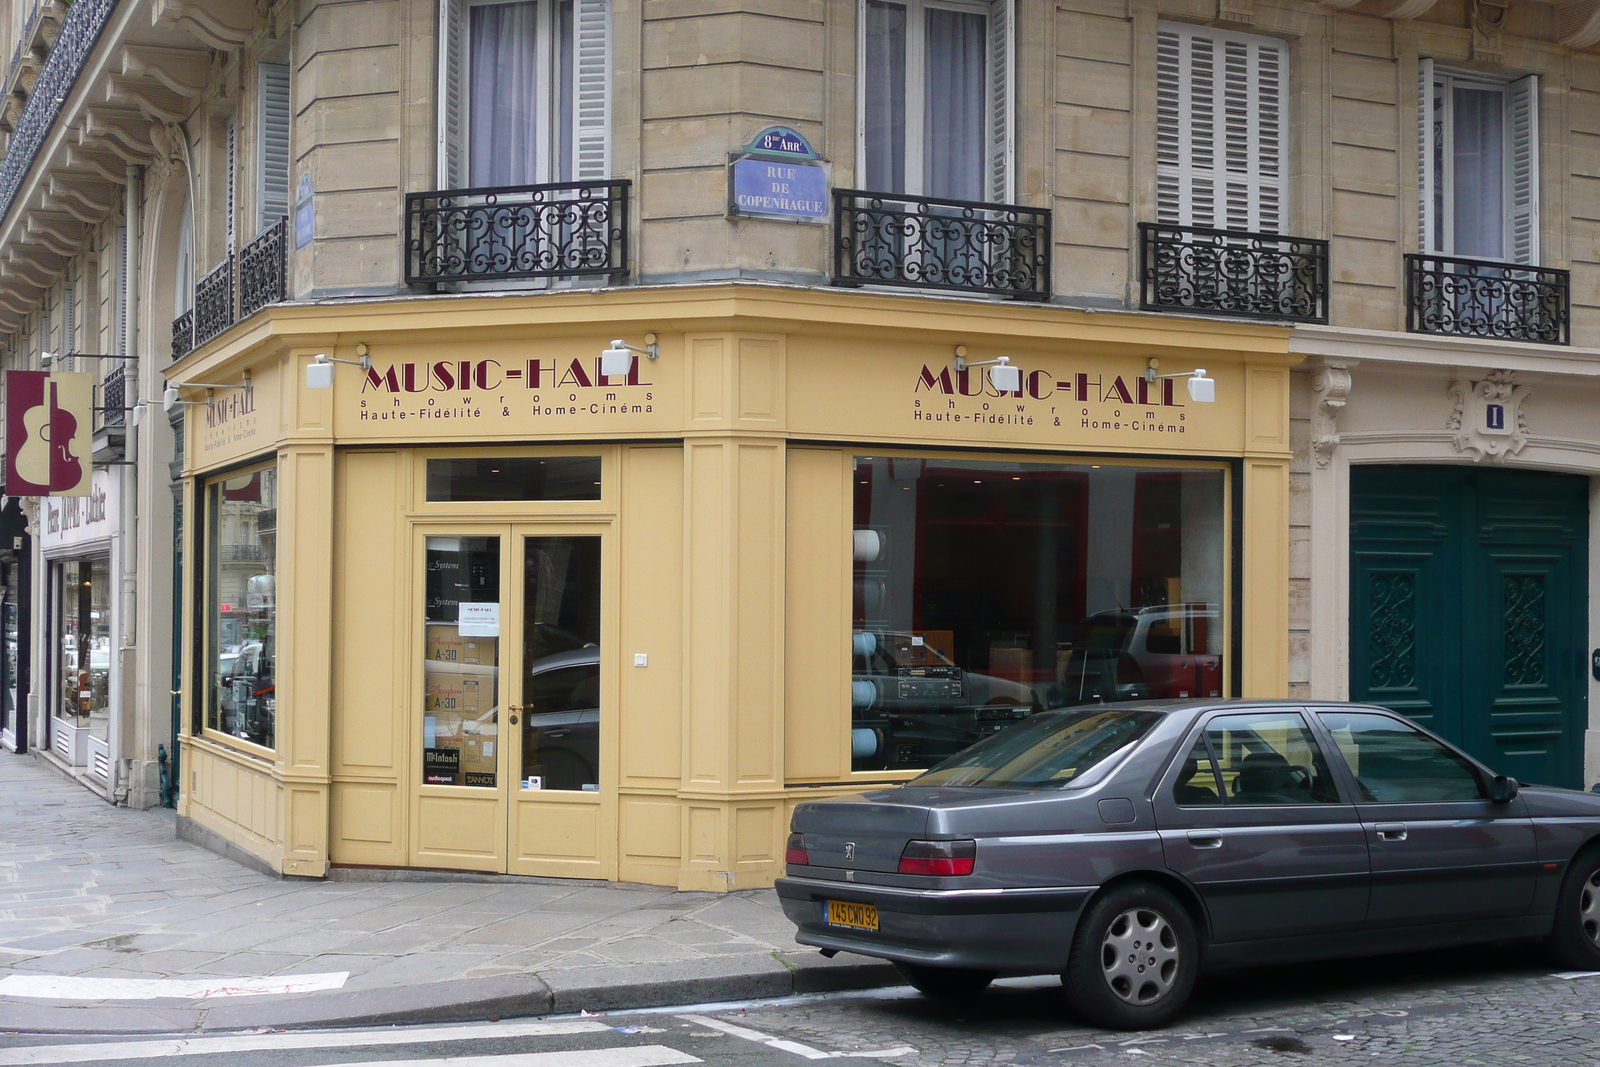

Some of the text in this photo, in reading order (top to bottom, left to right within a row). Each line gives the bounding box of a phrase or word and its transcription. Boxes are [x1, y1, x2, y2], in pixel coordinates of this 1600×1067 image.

[767, 166, 795, 180] RUE
[771, 182, 790, 194] DE
[738, 194, 823, 213] COPENHAGUE
[361, 355, 653, 394] MUSIC-HALL
[914, 363, 1185, 407] MUSIC-HALL
[360, 403, 653, 420] Haute-Fidélité & Home-Cinéma
[914, 410, 1186, 433] Haute-Fidélité & Home-Cinéma
[434, 559, 459, 571] System
[434, 596, 459, 608] System
[435, 649, 457, 660] A-30
[434, 697, 456, 709] A-30
[466, 776, 494, 784] TANNOY
[832, 903, 847, 922] 145
[865, 906, 877, 927] 92
